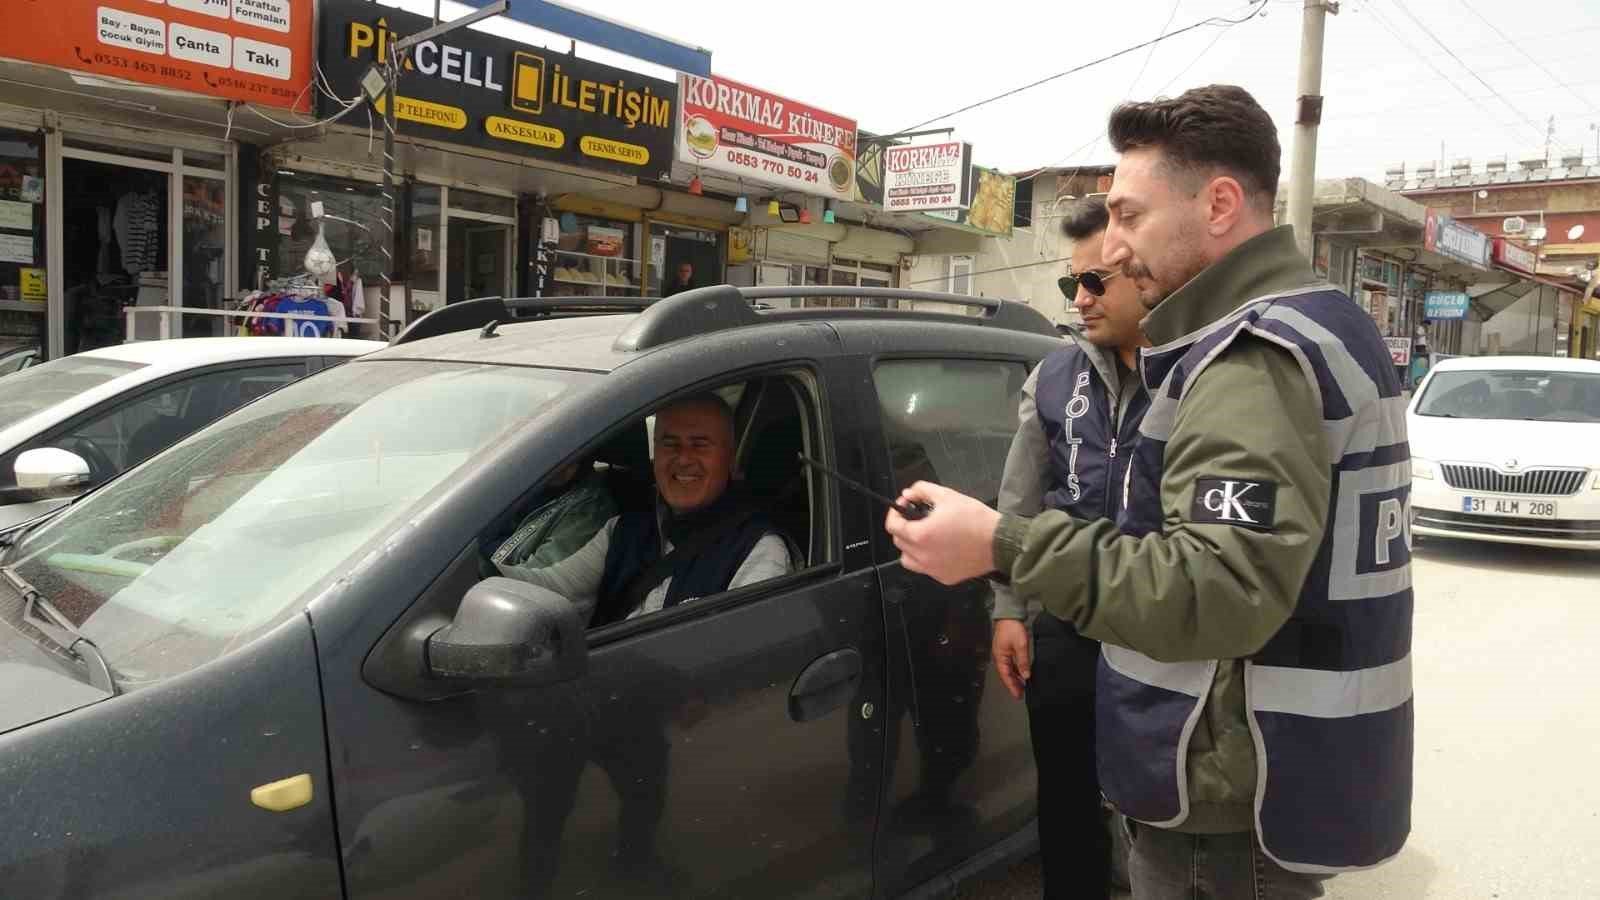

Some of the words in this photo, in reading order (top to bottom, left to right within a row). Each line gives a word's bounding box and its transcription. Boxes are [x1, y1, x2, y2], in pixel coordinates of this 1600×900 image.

[101, 16, 120, 29] Bay
[130, 23, 161, 37] Bayan
[100, 29, 132, 43] Çocuk
[135, 36, 164, 50] Giyim
[175, 35, 220, 54] Çanta
[245, 50, 280, 68] Takı
[551, 64, 670, 128] İLETİŞİM
[406, 105, 458, 123] TELEFONU
[685, 76, 784, 130] KORKMAZ
[787, 111, 854, 148] KÜNEFE
[494, 122, 557, 144] AKSESUAR
[727, 150, 758, 169] 0553
[761, 159, 784, 175] 770
[787, 165, 801, 179] 50
[804, 170, 818, 184] 24
[890, 145, 960, 171] KORKMAZ
[257, 183, 271, 230] CEP
[1472, 499, 1486, 512] 31
[1494, 500, 1519, 514] ALM
[1529, 502, 1553, 516] 208
